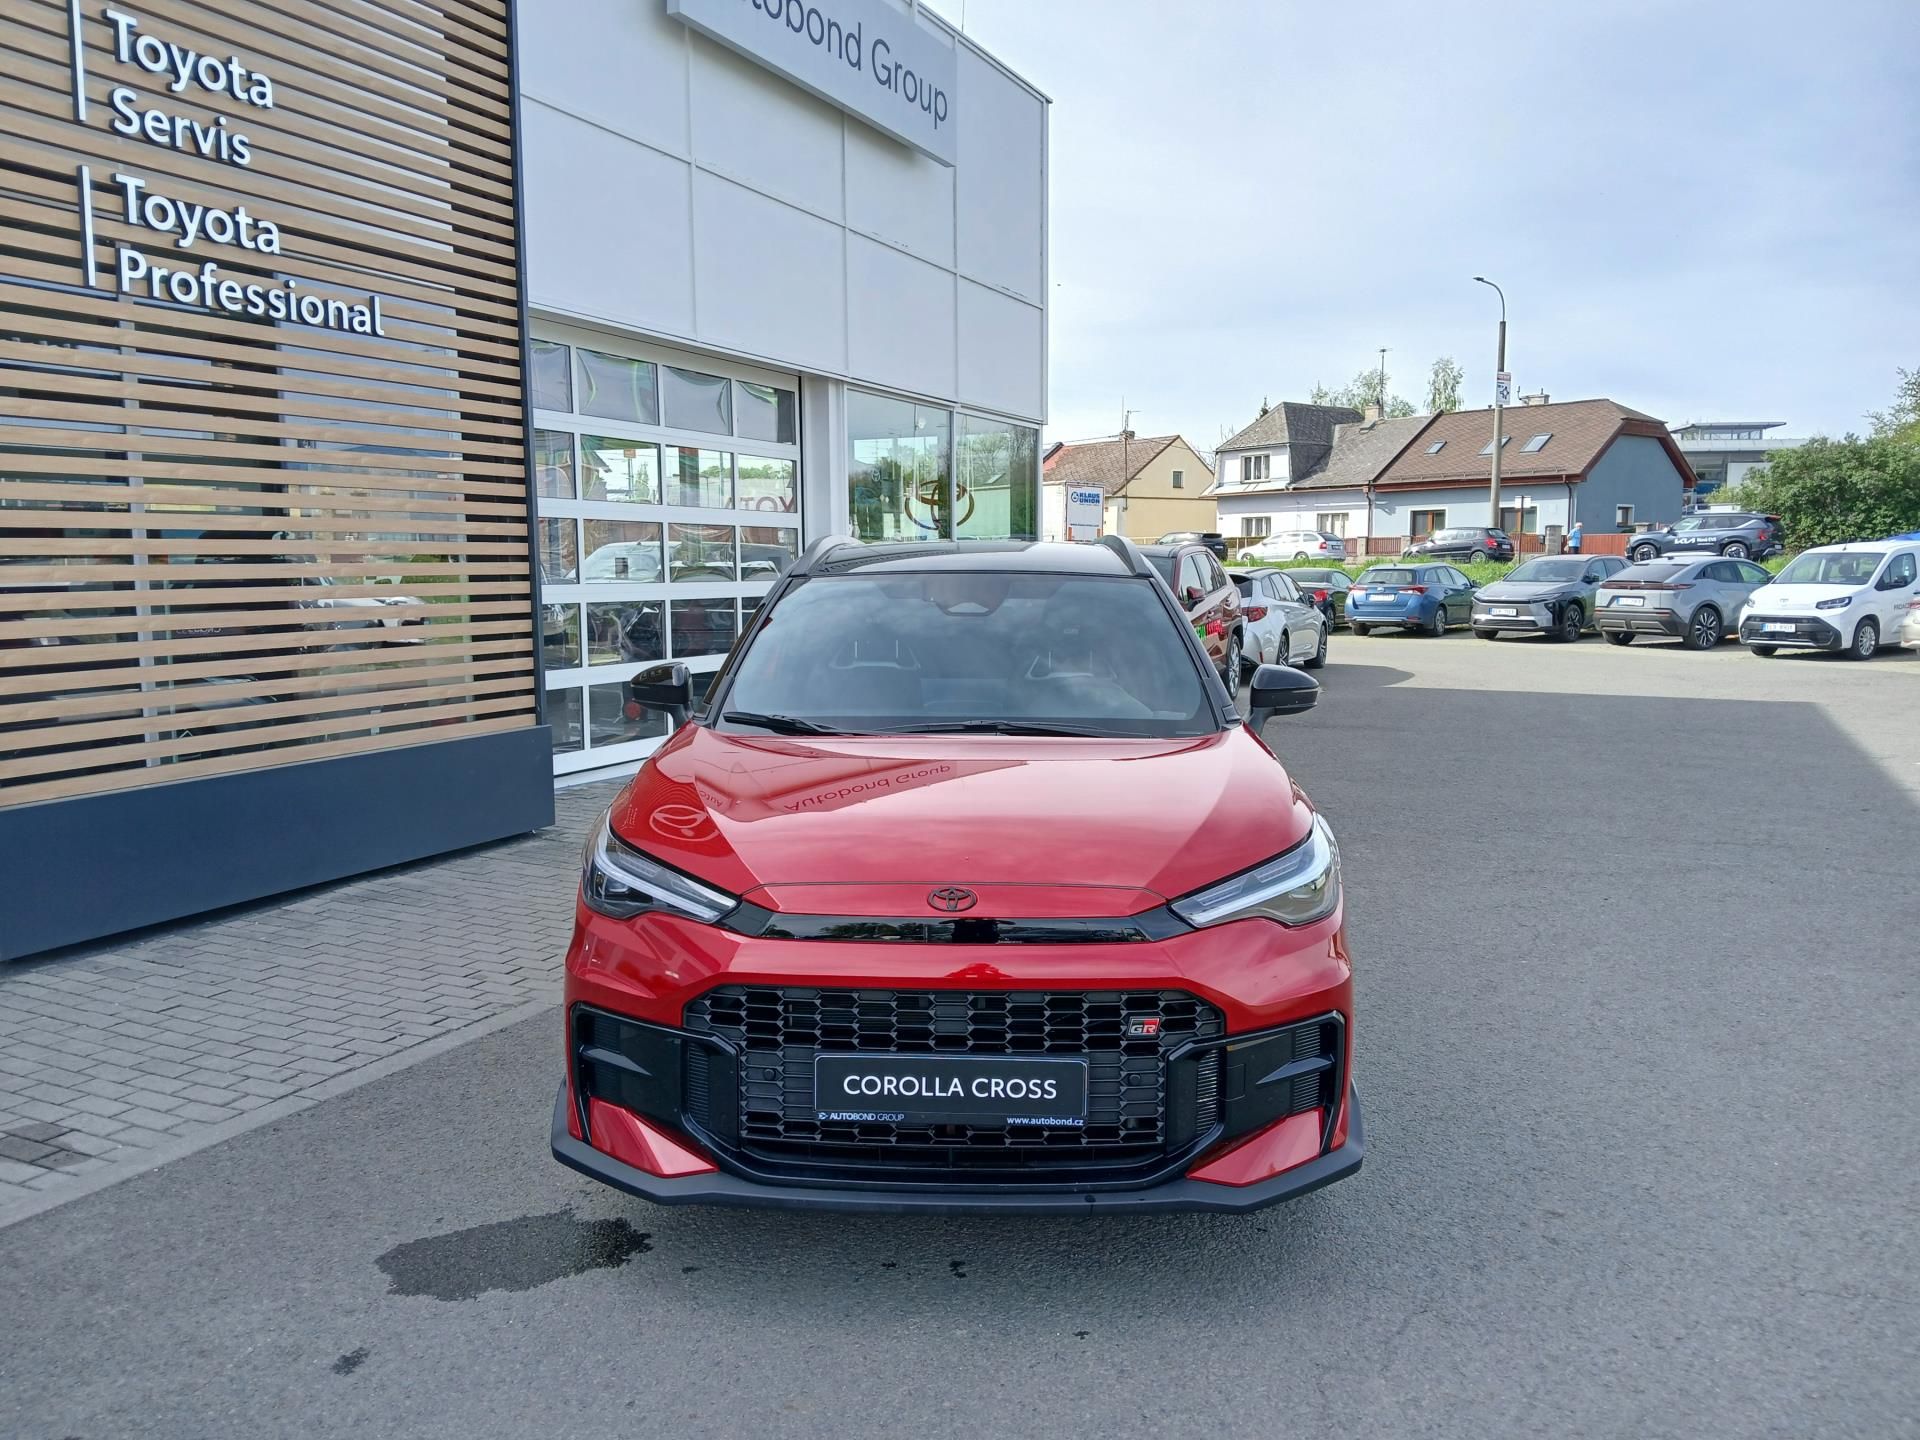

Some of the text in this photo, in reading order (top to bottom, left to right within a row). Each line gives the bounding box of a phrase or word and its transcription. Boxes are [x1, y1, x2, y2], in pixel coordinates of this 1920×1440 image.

[104, 8, 274, 109] Toyota
[751, 0, 948, 130] obond Group
[112, 88, 251, 166] Servis
[115, 173, 280, 255] Toyota
[120, 248, 385, 337] Professional
[829, 1112, 1084, 1127] AUTOBOND GROUP www.autobond.cz
[843, 1074, 1057, 1100] COROLLA CROSS
